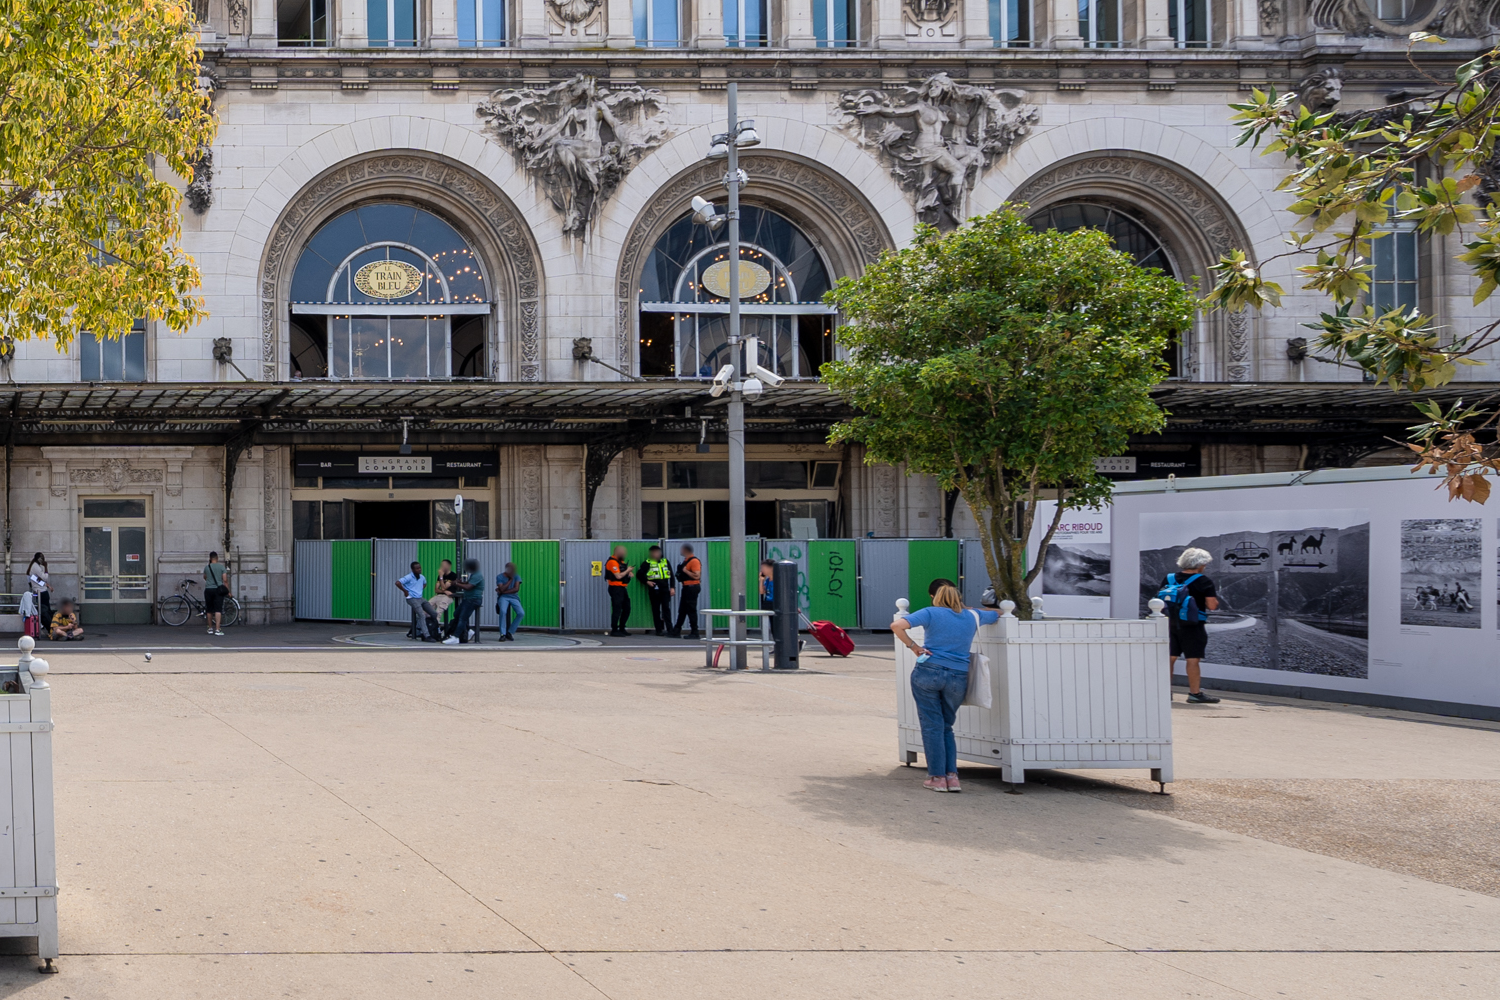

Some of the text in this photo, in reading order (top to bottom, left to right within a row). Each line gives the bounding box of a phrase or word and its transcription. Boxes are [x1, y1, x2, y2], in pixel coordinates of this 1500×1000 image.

[374, 272, 402, 280] TRAIN
[377, 282, 401, 290] BLEU
[1072, 522, 1103, 531] RIBOUD
